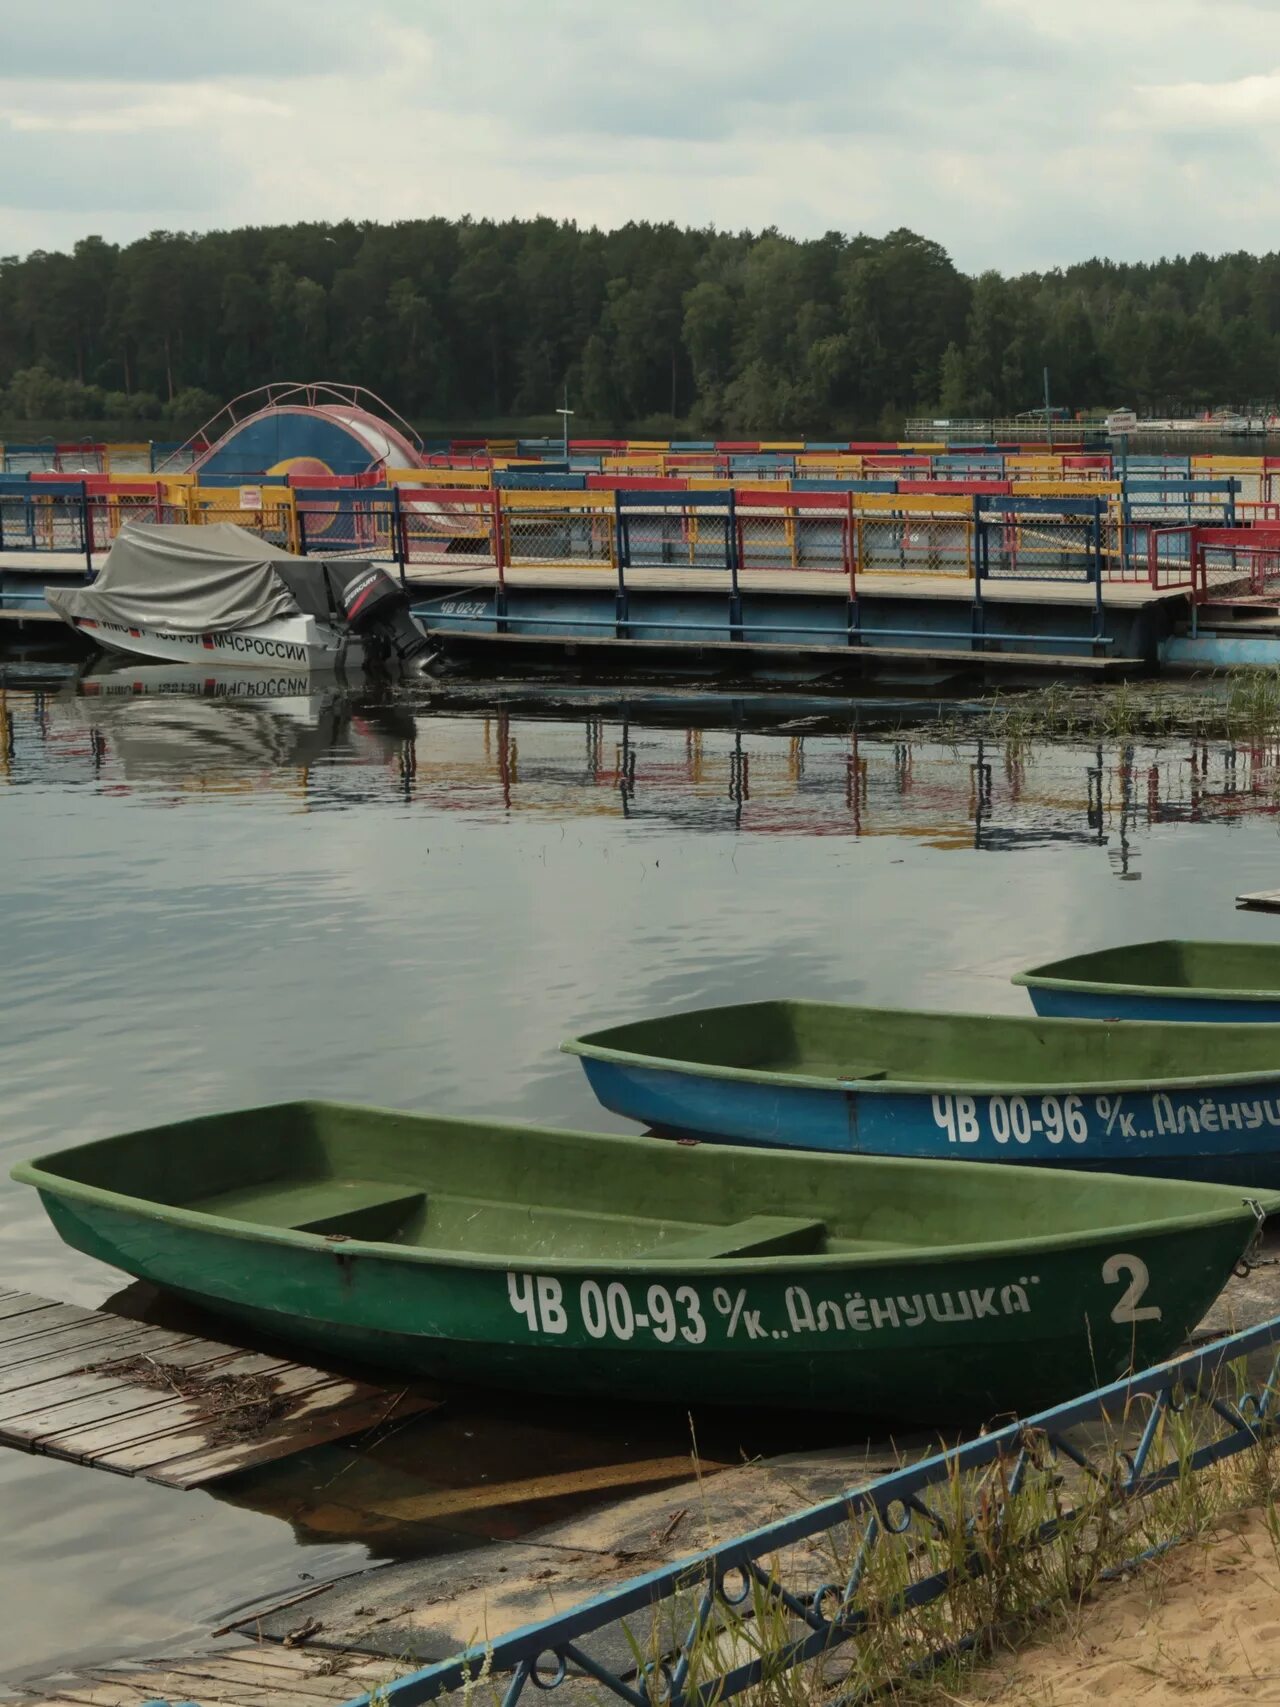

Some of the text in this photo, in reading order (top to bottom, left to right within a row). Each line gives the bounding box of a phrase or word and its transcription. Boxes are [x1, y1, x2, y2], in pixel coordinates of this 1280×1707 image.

[931, 1095, 980, 1143] ЧВ
[988, 1095, 1089, 1144] 00-96
[506, 1271, 568, 1335] ЧВ
[580, 1279, 707, 1344] 00-93
[1102, 1253, 1162, 1324] 2
